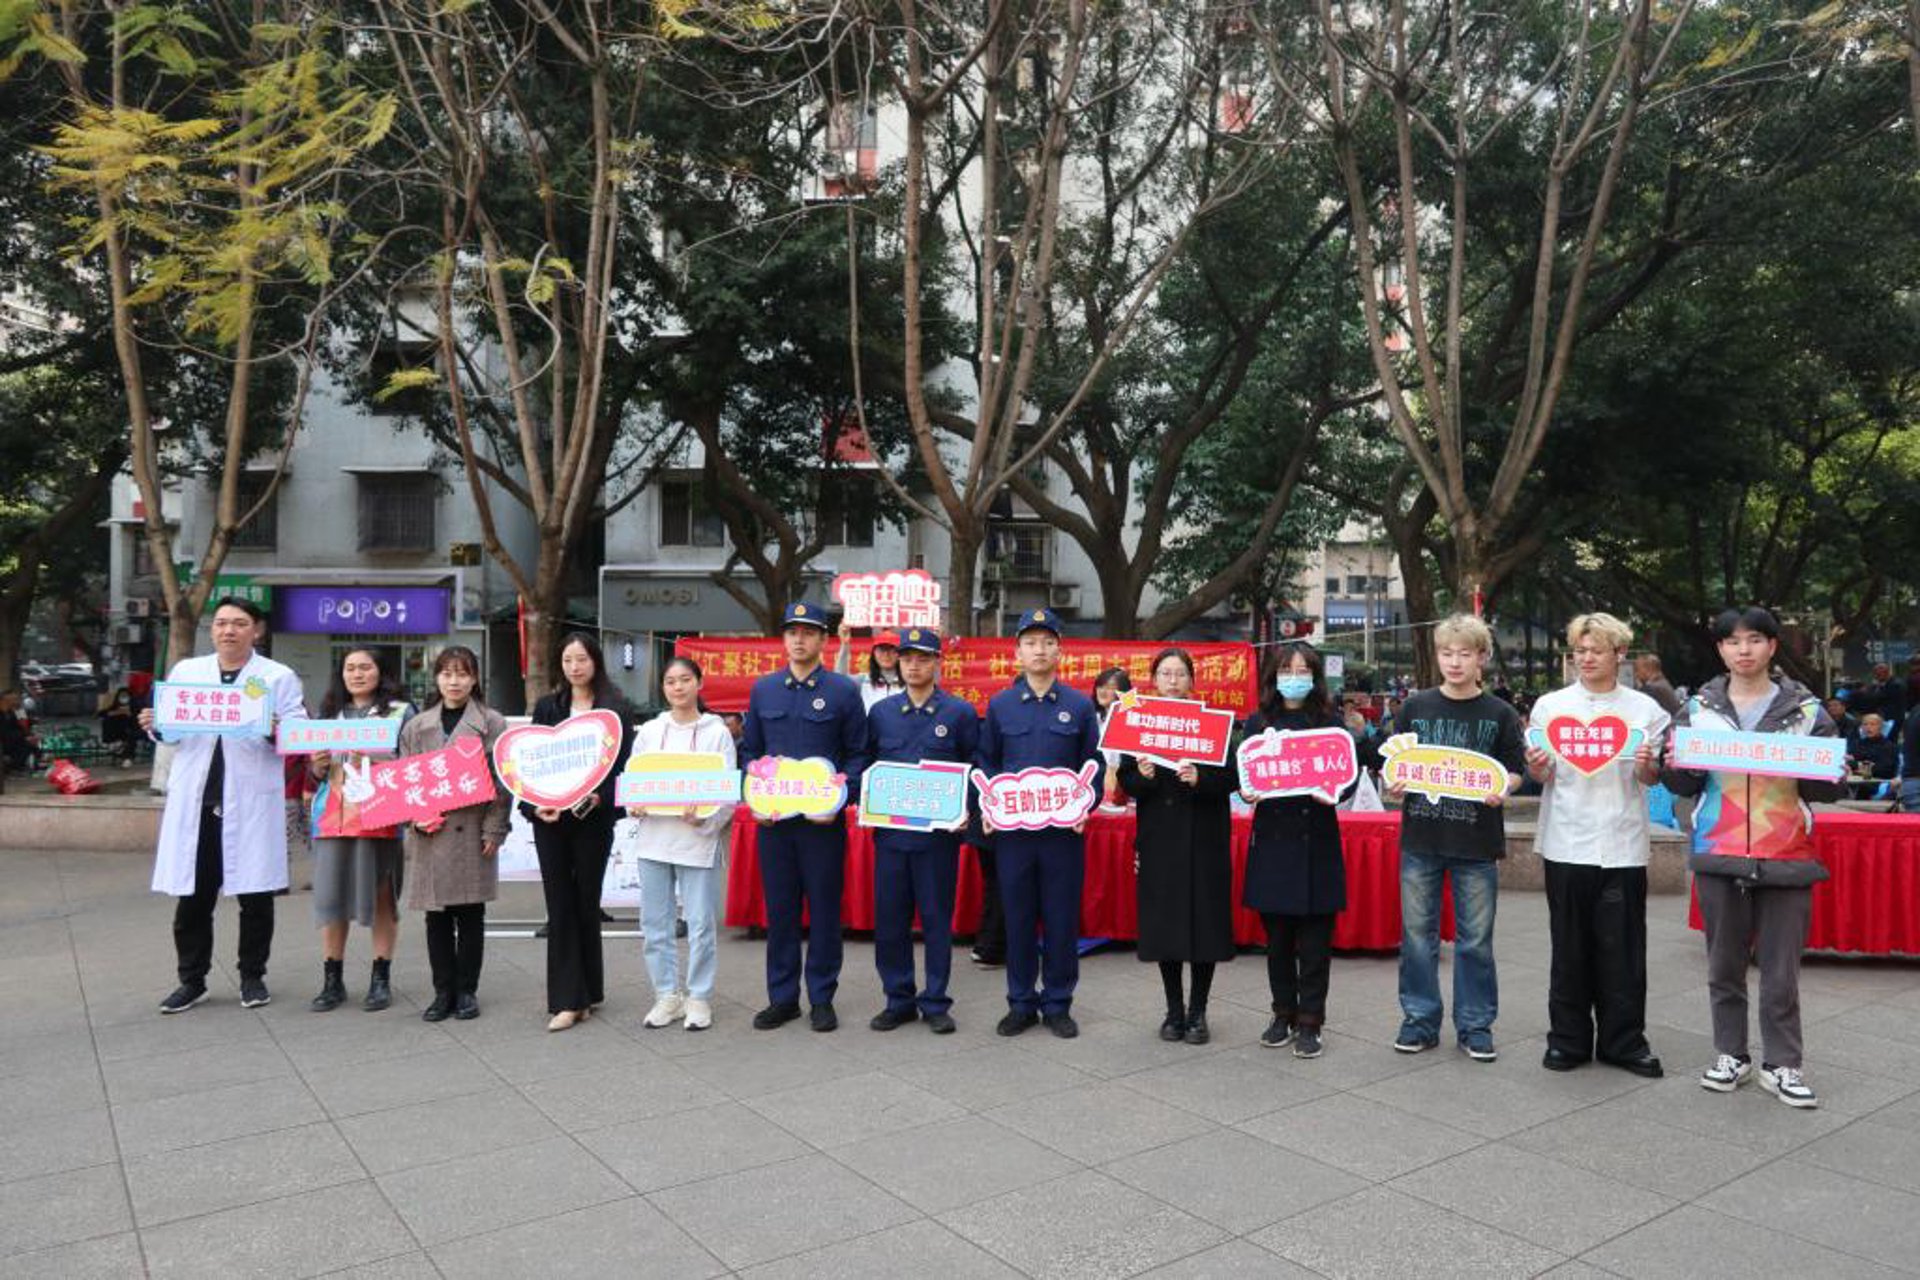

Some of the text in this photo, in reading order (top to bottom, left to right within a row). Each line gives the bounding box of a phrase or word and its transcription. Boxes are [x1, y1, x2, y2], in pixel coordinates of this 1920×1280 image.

[318, 597, 391, 624] POPO
[176, 690, 241, 706] 专业使命
[174, 707, 241, 722] 助人自助
[1125, 710, 1201, 734] 建功新时代
[1139, 732, 1215, 754] 志愿更精彩
[1002, 788, 1070, 815] 互助进步
